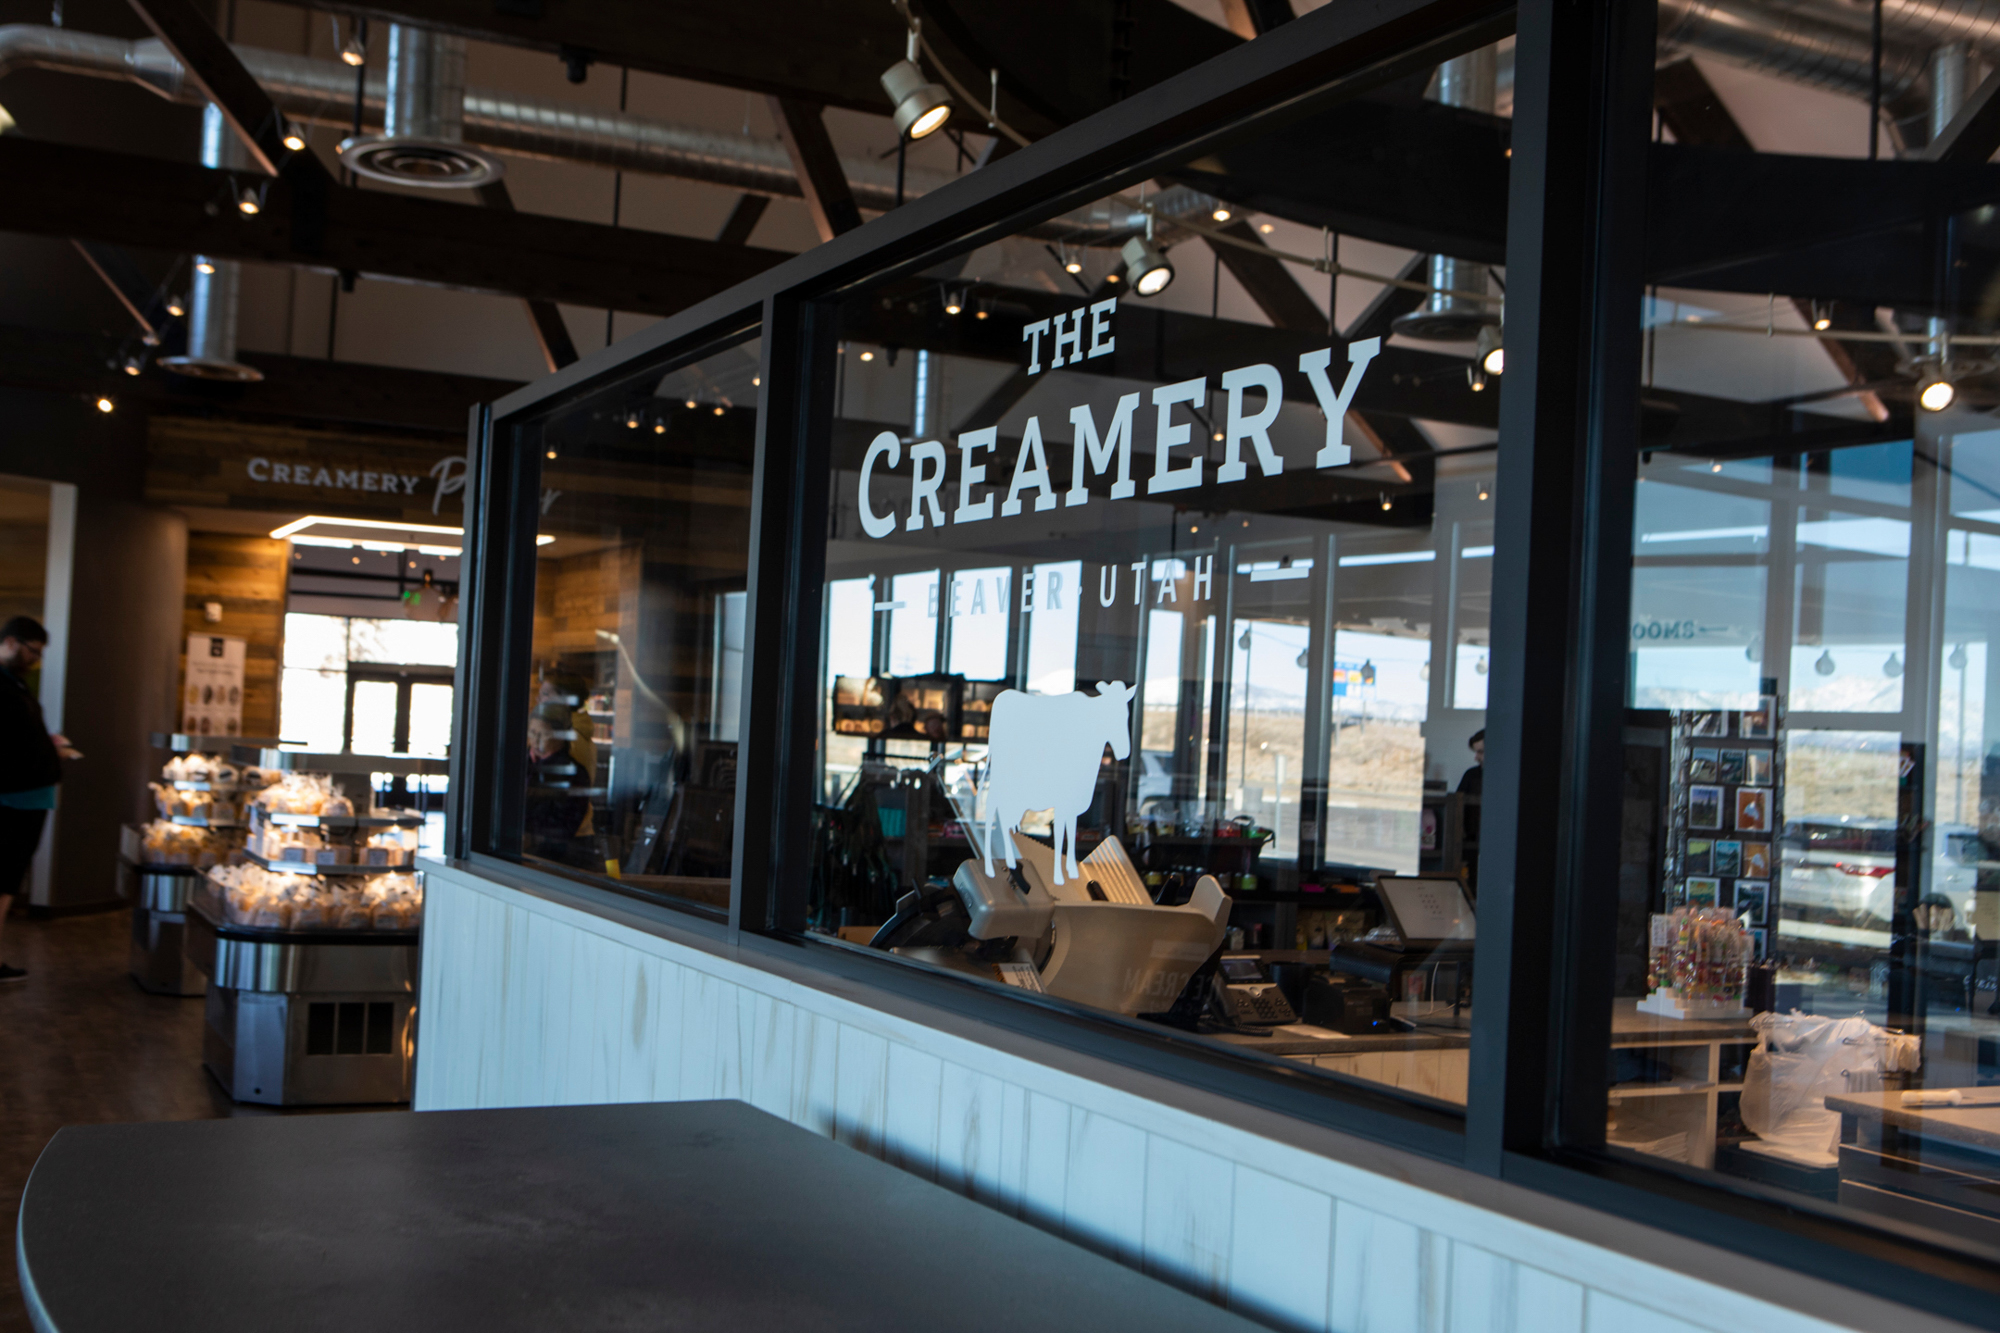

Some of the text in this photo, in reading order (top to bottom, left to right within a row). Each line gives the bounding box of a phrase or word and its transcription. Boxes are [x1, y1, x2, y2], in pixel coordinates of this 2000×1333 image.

[1022, 297, 1117, 375] THE
[858, 336, 1381, 539] CREAMERY
[247, 457, 420, 495] CREAMERY
[927, 555, 1214, 618] BEAVER UTAH
[1632, 620, 1695, 640] OOMS
